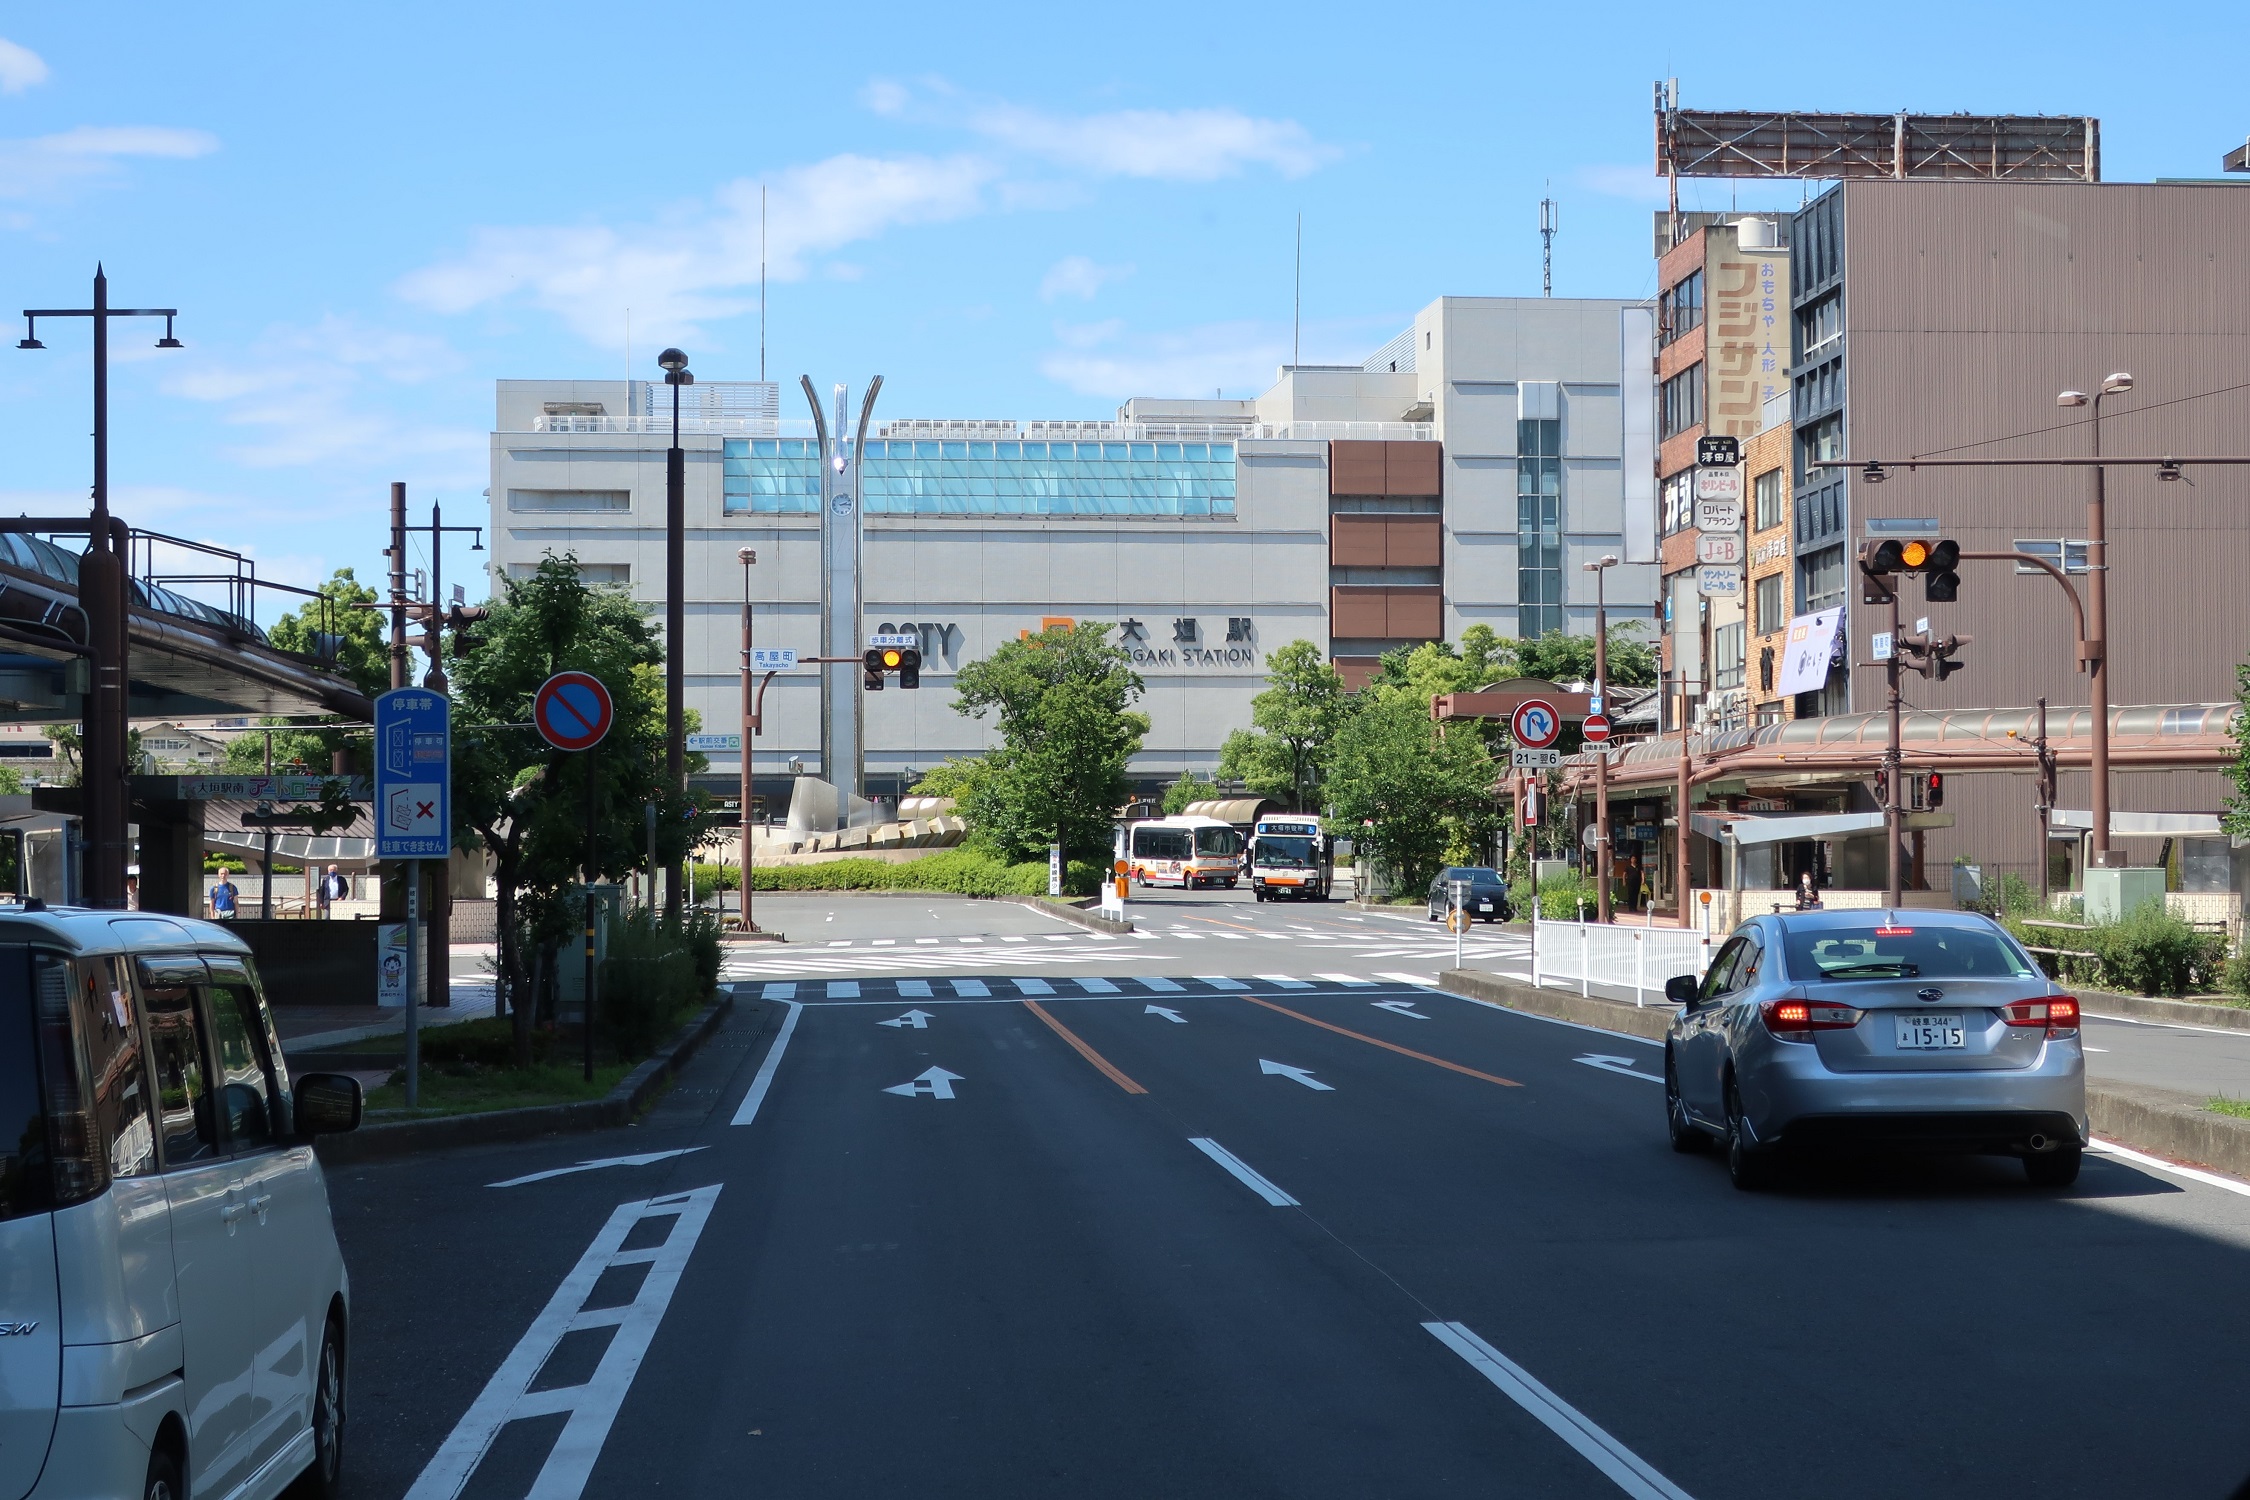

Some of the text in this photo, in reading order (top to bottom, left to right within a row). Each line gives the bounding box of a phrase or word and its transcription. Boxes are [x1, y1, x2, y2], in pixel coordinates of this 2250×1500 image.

[1701, 452, 1736, 463] 澤田屋
[1701, 480, 1737, 491] キリンビール
[1703, 506, 1735, 515] ロバート
[1703, 517, 1735, 526] ブラウン
[1704, 542, 1735, 560] J&B
[1703, 570, 1736, 580] サントリー
[1703, 581, 1736, 591] ビール生
[1119, 618, 1252, 642] 大垣駅
[871, 636, 912, 644] 歩車分離式
[754, 651, 794, 662] 高屋町
[1183, 649, 1251, 662] STATION
[392, 698, 433, 711] 停車帯
[414, 737, 443, 746] 停車可
[198, 781, 245, 794] 大垣駅南
[724, 800, 739, 808] ASTY
[382, 841, 443, 854] 駐車できません
[1914, 1028, 1961, 1045] 15-15
